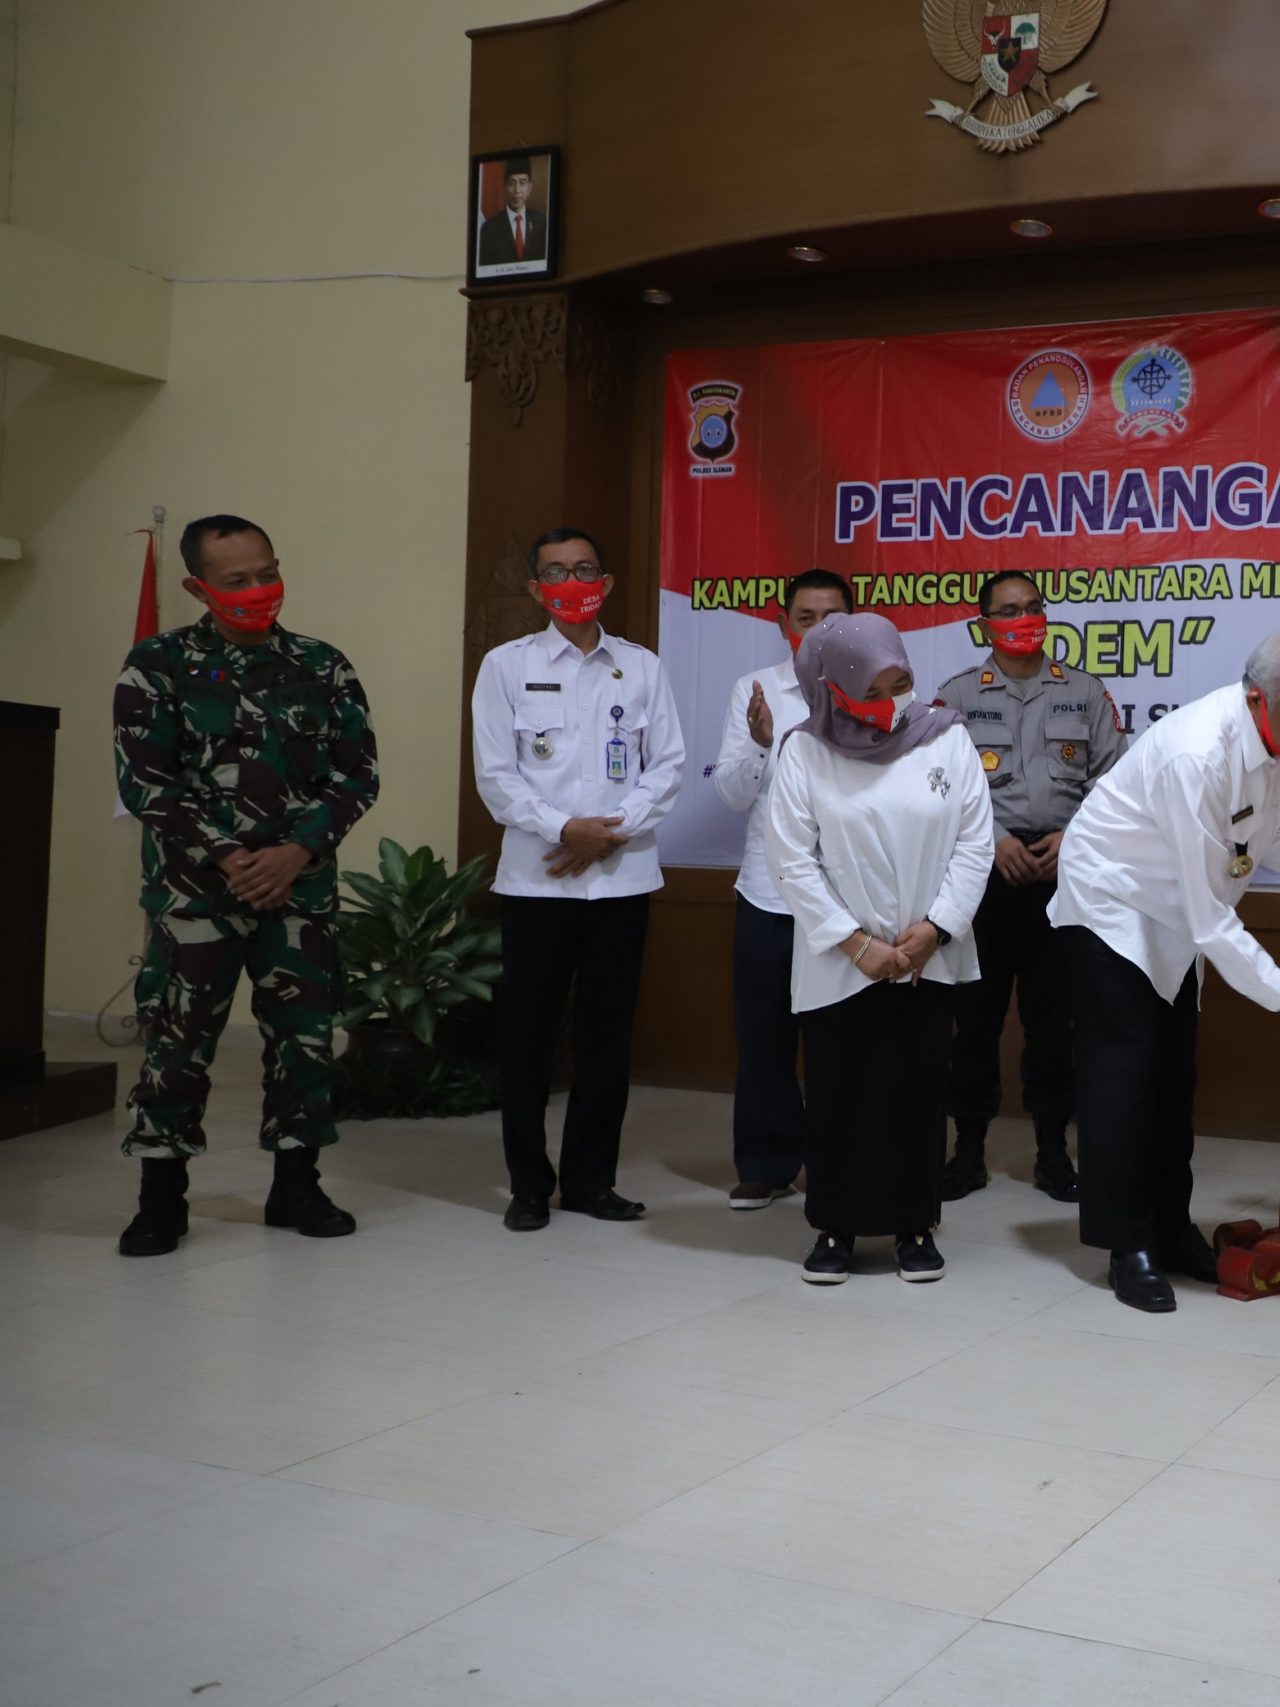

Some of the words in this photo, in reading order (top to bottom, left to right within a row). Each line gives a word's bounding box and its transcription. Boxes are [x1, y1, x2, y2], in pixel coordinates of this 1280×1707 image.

[1012, 369, 1029, 399] BADAN
[1028, 353, 1088, 394] PENANGGULANGAN
[1012, 400, 1050, 436] BENCANA
[1054, 396, 1087, 435] DAERAH
[692, 575, 787, 609] KAMP
[852, 571, 996, 606] TANGGU
[1053, 703, 1087, 713] POLRI
